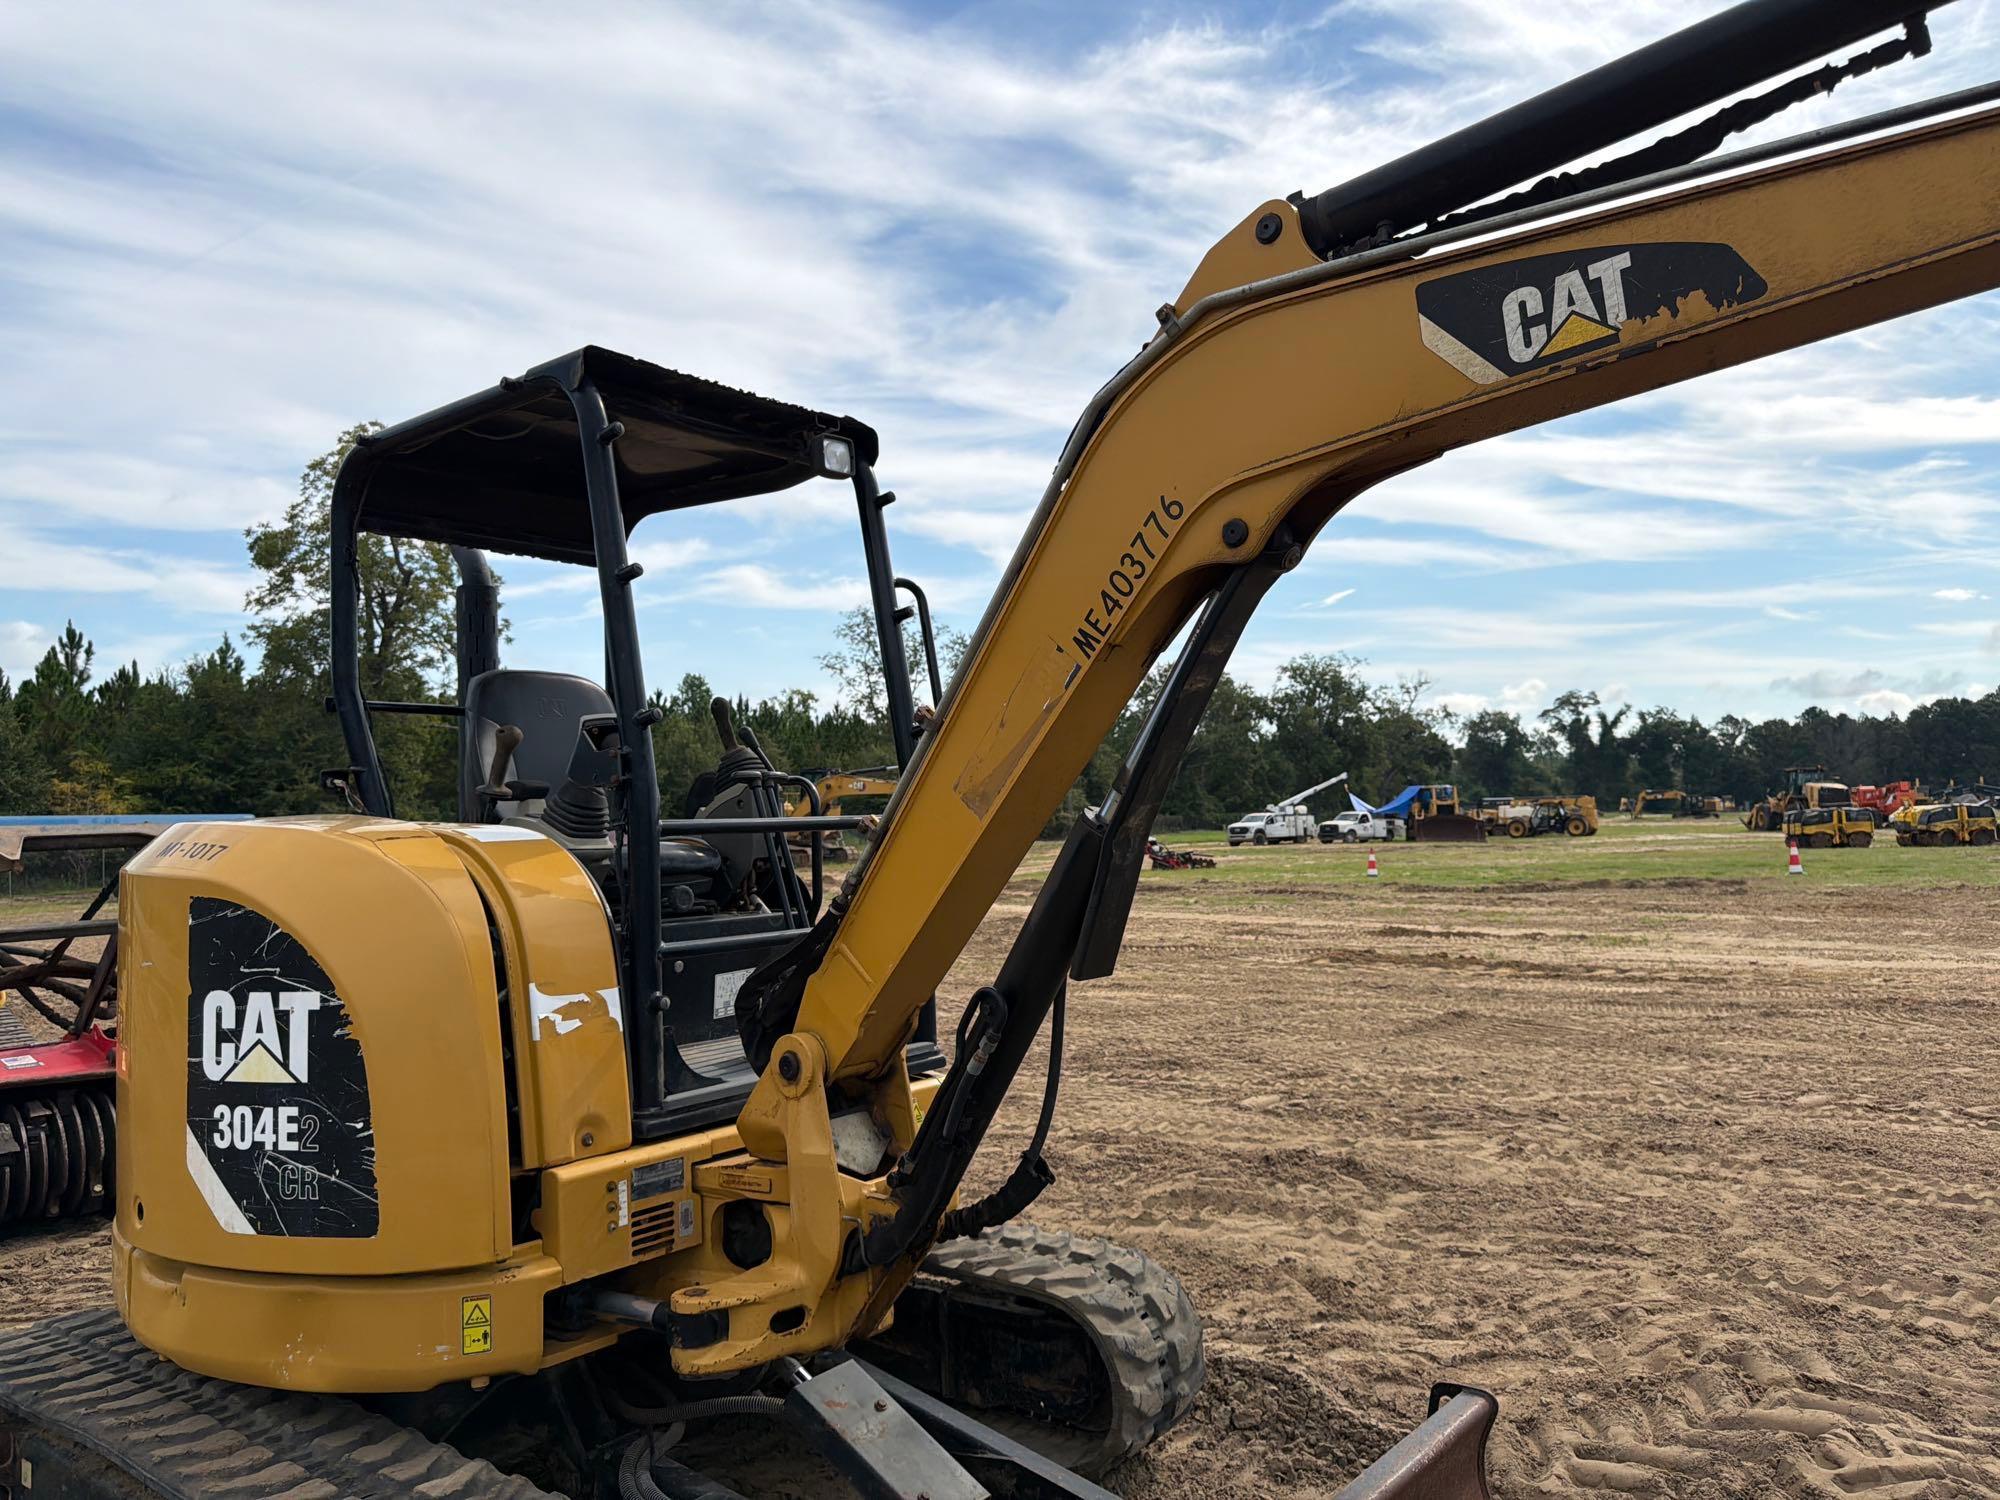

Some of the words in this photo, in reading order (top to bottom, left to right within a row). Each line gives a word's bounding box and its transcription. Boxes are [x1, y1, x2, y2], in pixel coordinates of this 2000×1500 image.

[1502, 251, 1632, 363] CAT
[1072, 495, 1184, 660] ME403776
[202, 990, 320, 1083] CAT
[279, 1164, 319, 1200] CR
